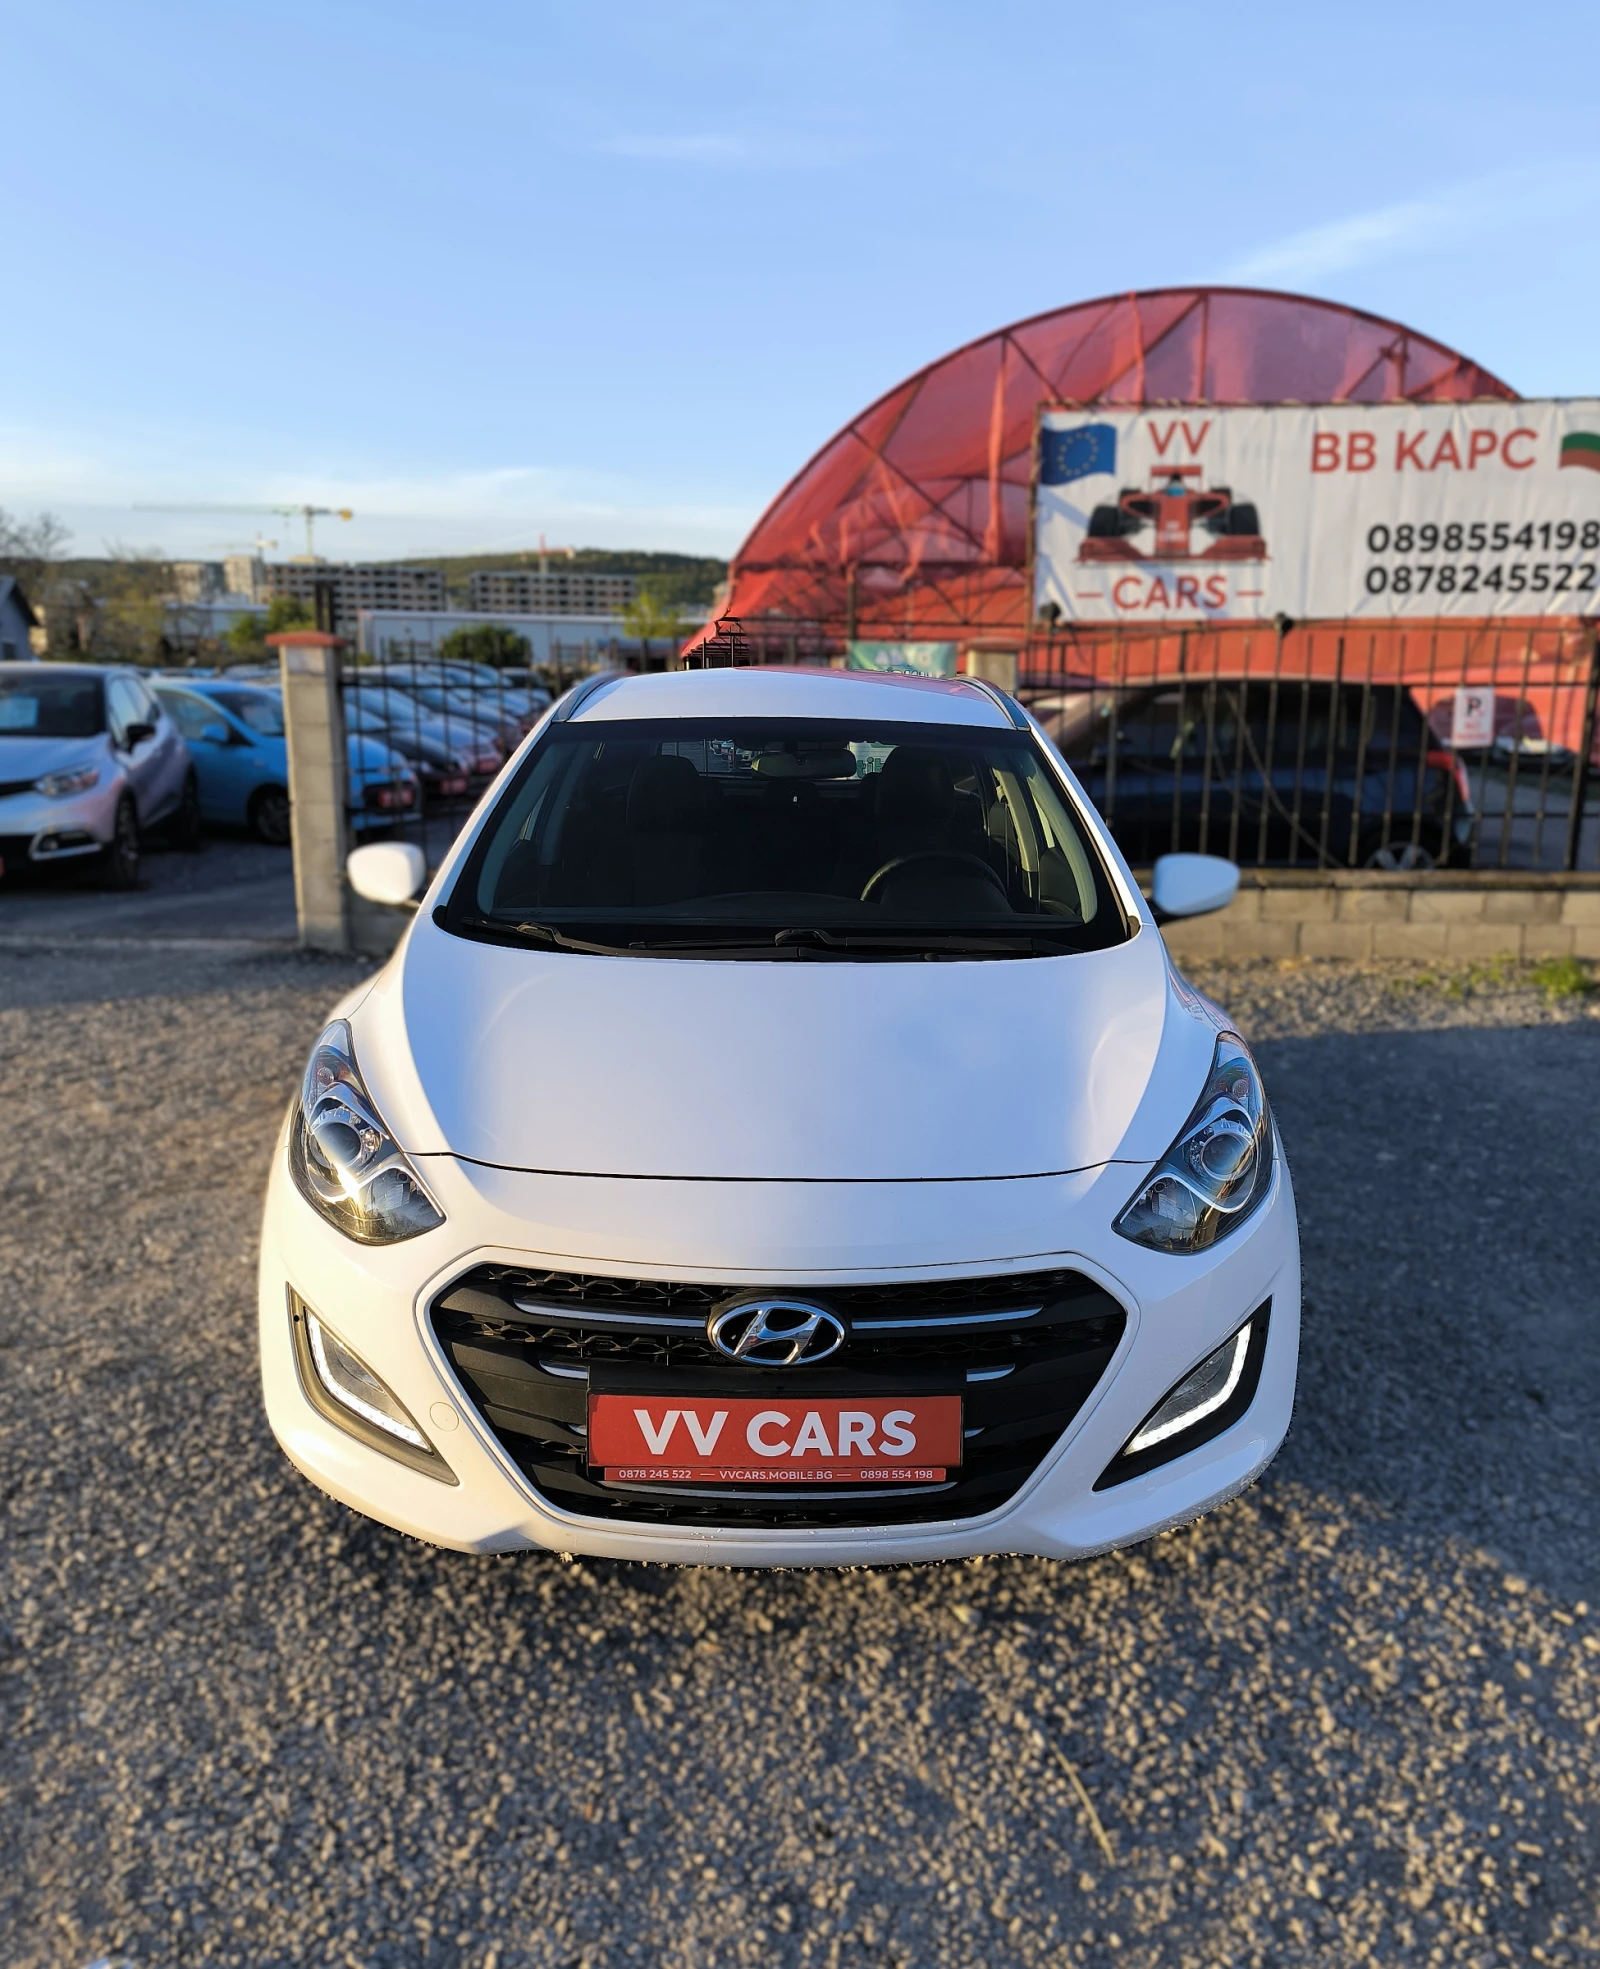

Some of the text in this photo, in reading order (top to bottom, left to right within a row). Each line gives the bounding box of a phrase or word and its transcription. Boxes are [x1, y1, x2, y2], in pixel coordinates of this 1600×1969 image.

[1147, 420, 1212, 457] VV
[1394, 427, 1539, 471] КАРС
[1367, 520, 1600, 553] 0898554198
[1112, 575, 1228, 611] CARS
[1365, 563, 1597, 594] 0878245522
[633, 1409, 917, 1457] VV CARS
[618, 1469, 933, 1480] 0878 245 522 VVCARS.MOBILE.BG 0898 554 198
